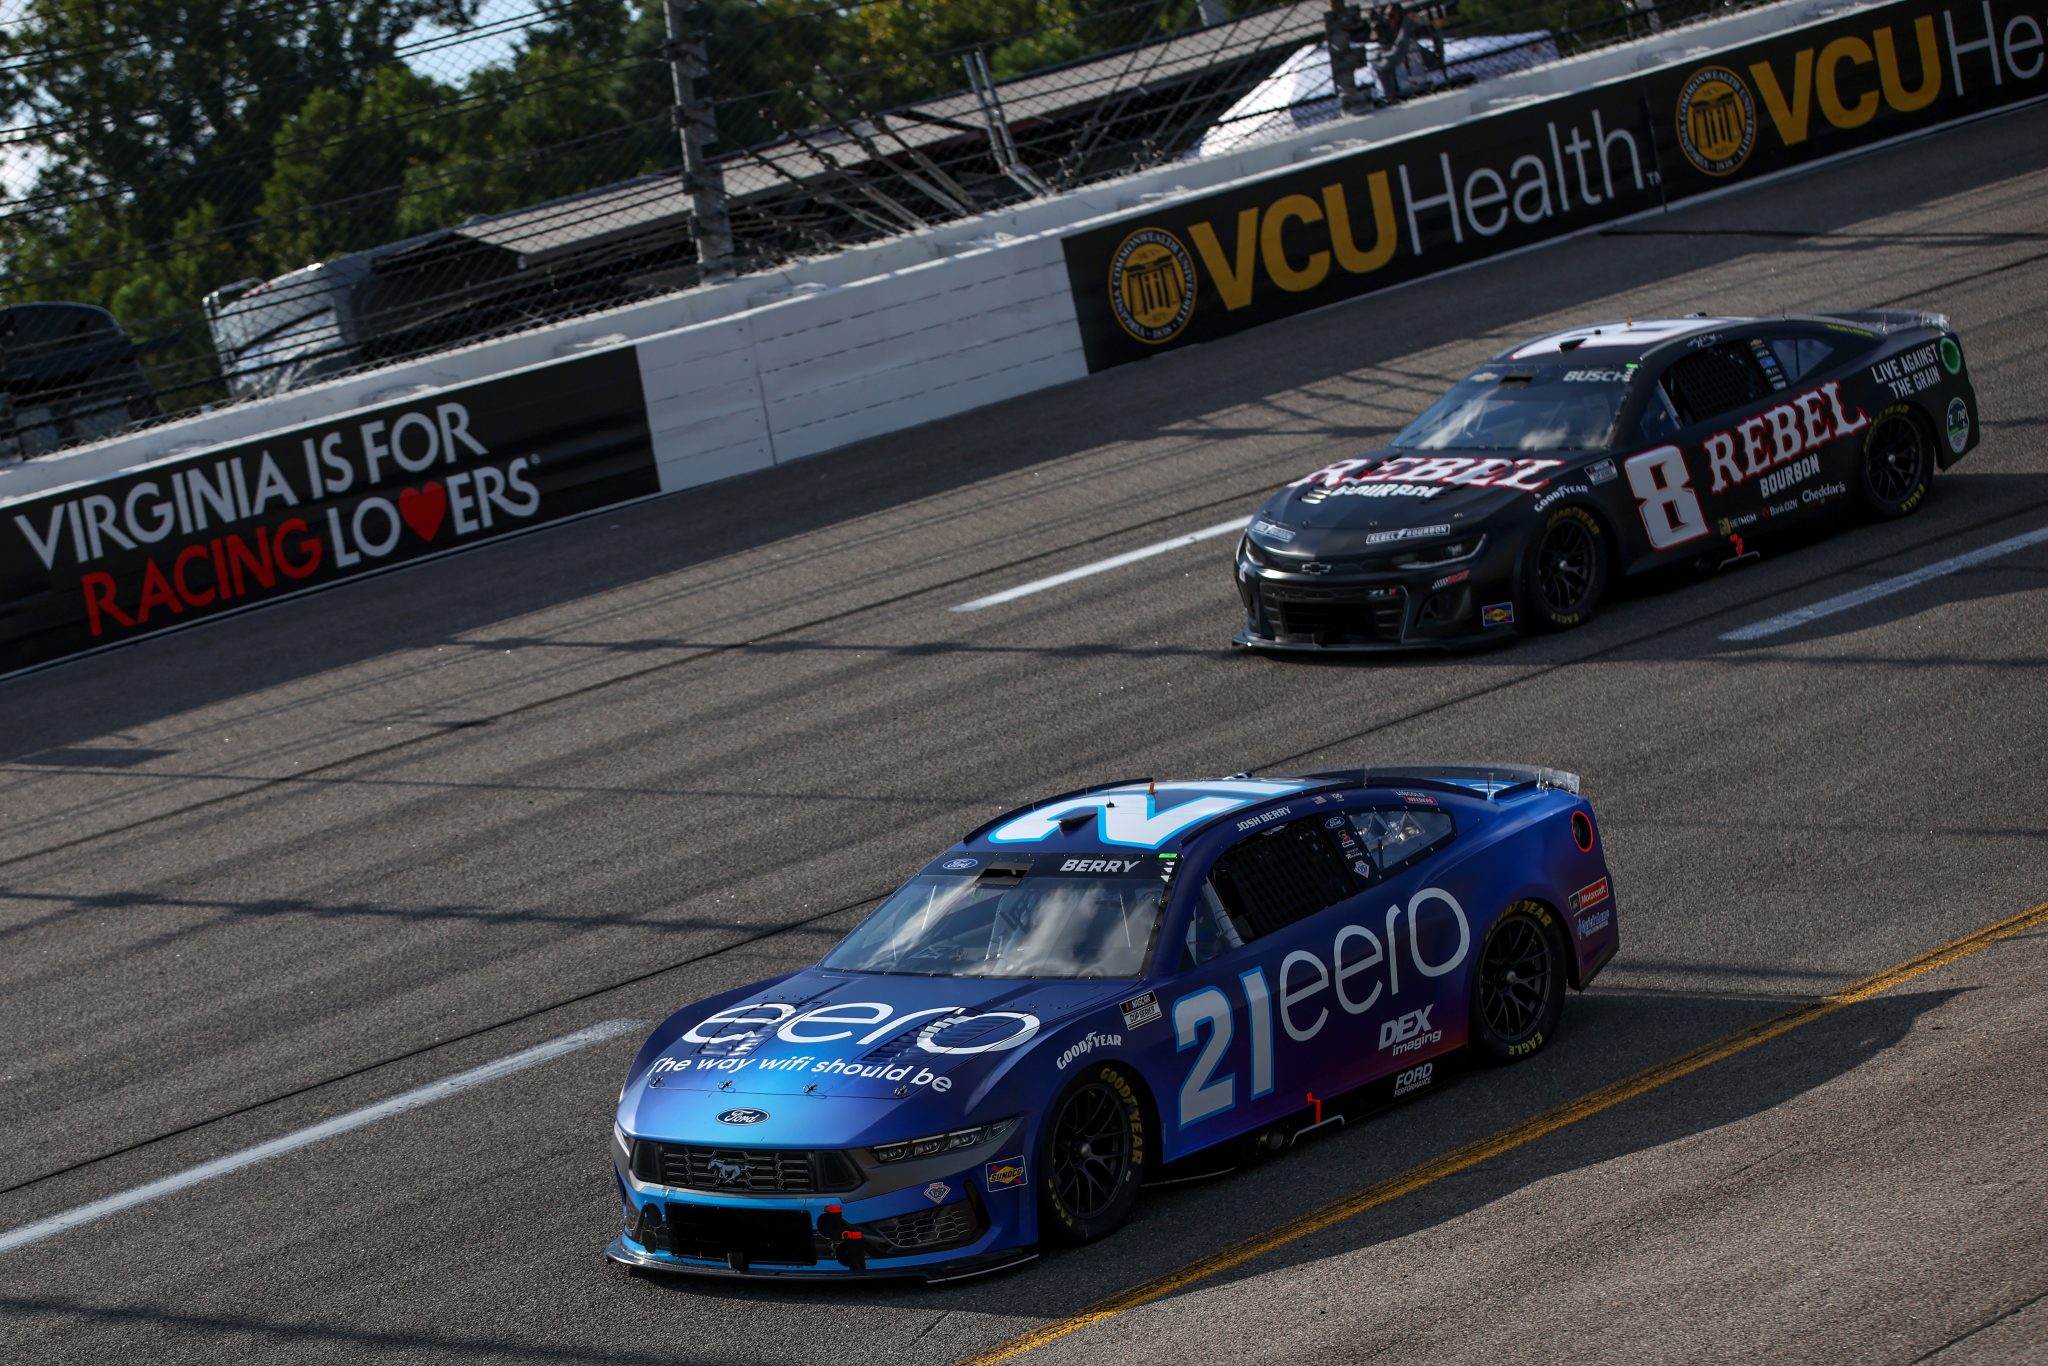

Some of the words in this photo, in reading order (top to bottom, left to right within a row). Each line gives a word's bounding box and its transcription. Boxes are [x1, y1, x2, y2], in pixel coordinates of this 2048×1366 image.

[1747, 14, 1943, 147] VCU
[1943, 0, 2048, 97] He
[1187, 168, 1398, 312] VCU
[1398, 107, 1645, 256] Health
[1871, 359, 1902, 385] LIVE
[1900, 343, 1940, 375] AGAINST
[1888, 376, 1915, 400] THE
[1912, 365, 1942, 392] GRAIN
[1701, 380, 1870, 496] REBEL
[13, 449, 300, 572] VIRGINIA
[301, 431, 355, 500] IS
[359, 401, 490, 485] FOR
[1285, 457, 1568, 491] REBEL
[1760, 453, 1821, 498] BOURBON
[1802, 481, 1847, 503] Cheddar's
[1534, 485, 1588, 512] GOODYEAR
[1623, 444, 1711, 550] 8
[1370, 532, 1396, 543] REBEL
[80, 516, 324, 638] RACING
[1236, 815, 1262, 832] JOSH
[1259, 805, 1292, 823] BERRY
[1060, 860, 1140, 873] BERRY
[1279, 887, 1471, 1042] eero
[681, 1002, 1041, 1055] eero
[1378, 1003, 1434, 1050] DEX
[1392, 1029, 1442, 1056] imaging
[1507, 1031, 1544, 1056] EAGLE
[1056, 1031, 1122, 1070] GOODYEAR
[1171, 965, 1275, 1131] 21
[696, 1057, 756, 1074] way
[758, 1055, 813, 1071] wifi
[811, 1057, 914, 1082] should
[909, 1068, 953, 1093] be
[1393, 1076, 1432, 1098] PERFORMANCE
[1395, 1062, 1433, 1089] FORD
[721, 1108, 765, 1124] Ford
[1098, 1066, 1144, 1166] GOODYEAR
[990, 1167, 1023, 1183] SUNOCO
